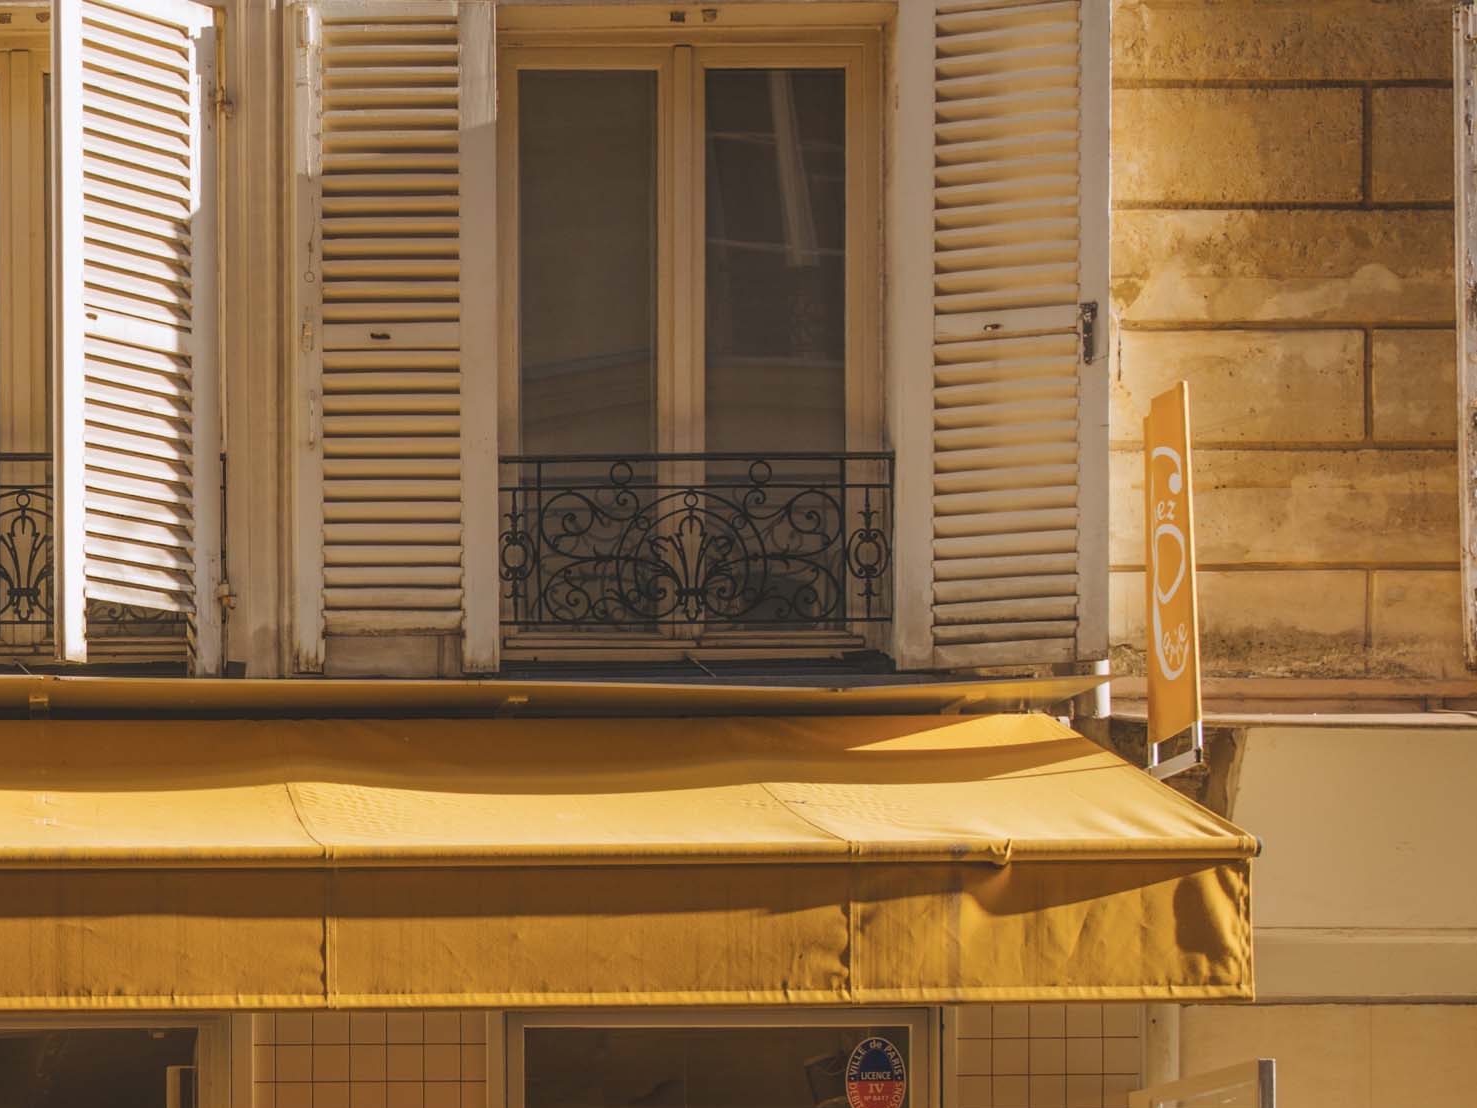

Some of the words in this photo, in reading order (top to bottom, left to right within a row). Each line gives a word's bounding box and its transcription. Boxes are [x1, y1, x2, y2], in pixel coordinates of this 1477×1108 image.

[850, 1046, 868, 1075] VILLE
[869, 1039, 882, 1049] de
[884, 1045, 903, 1075] PARIS
[860, 1071, 892, 1080] LICENCE
[868, 1083, 885, 1093] IV
